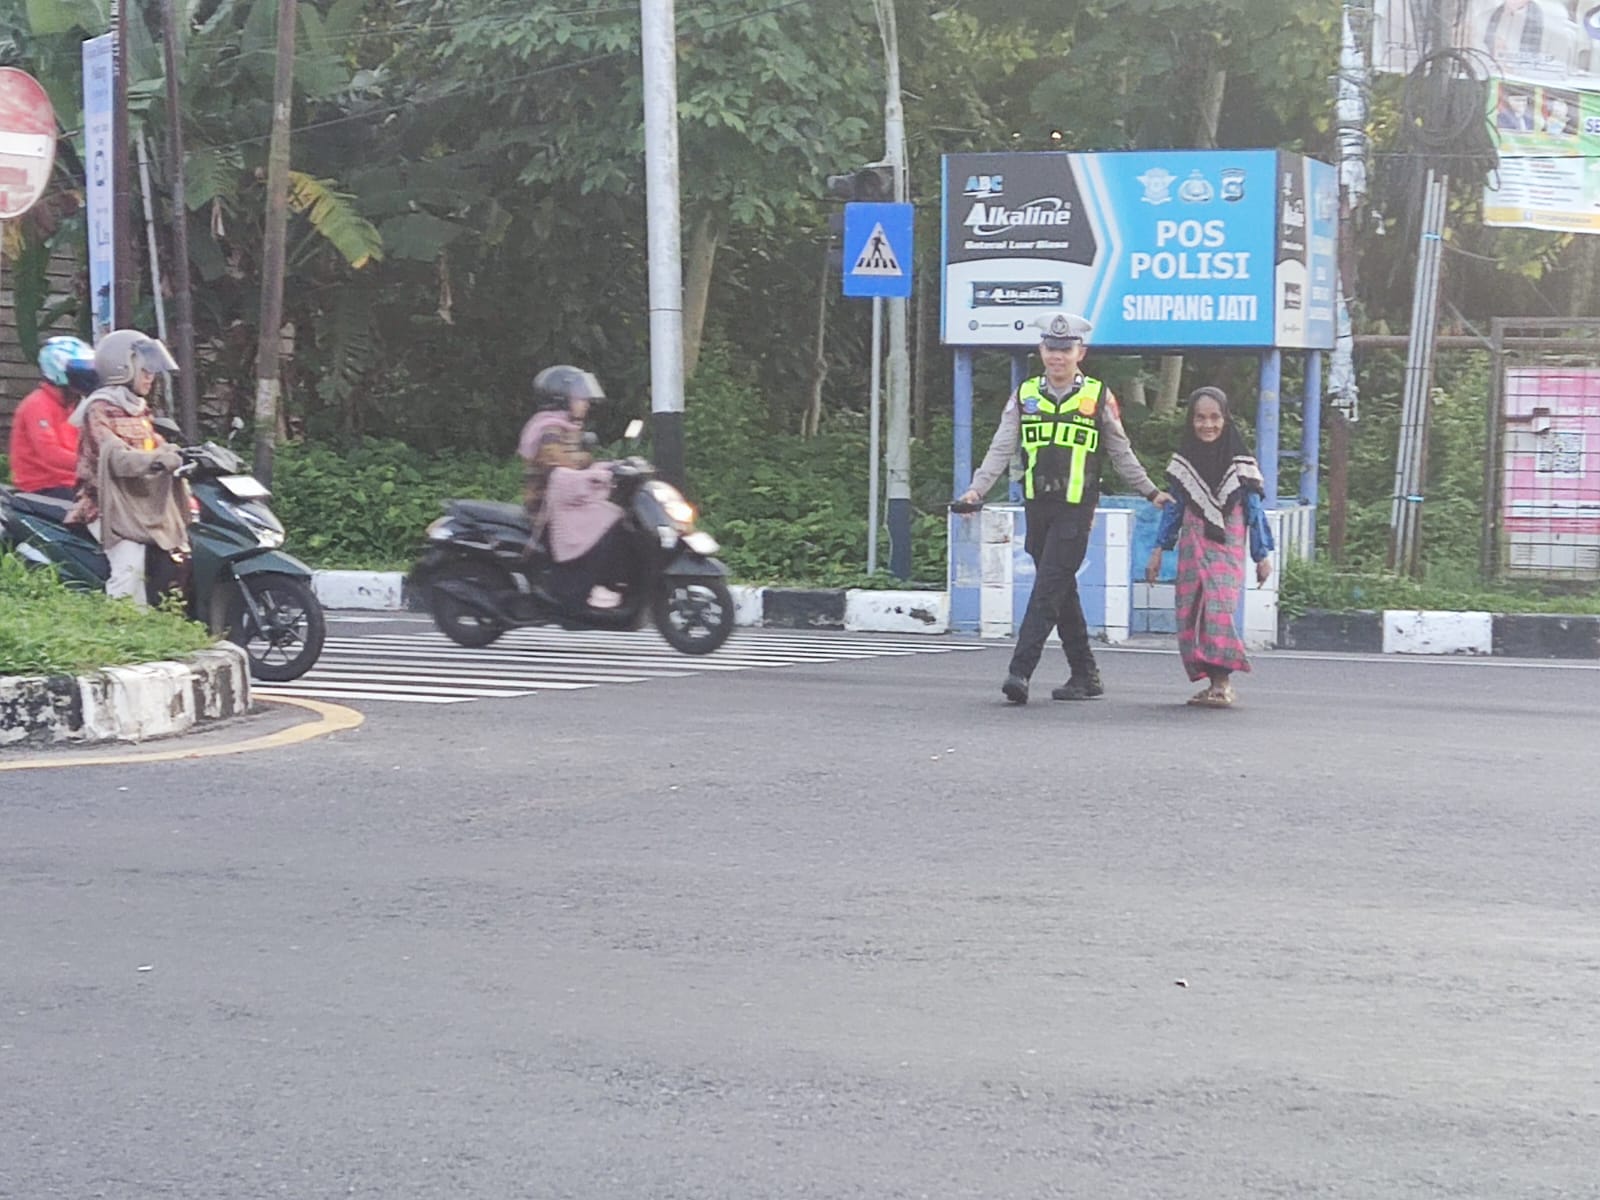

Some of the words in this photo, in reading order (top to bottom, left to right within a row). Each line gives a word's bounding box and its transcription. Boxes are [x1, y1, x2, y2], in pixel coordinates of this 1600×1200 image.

[964, 175, 1004, 192] ABC
[963, 201, 1072, 226] Alkaline
[1156, 219, 1226, 248] POS
[1130, 251, 1251, 280] POLISI
[1122, 294, 1214, 321] SIMPANG
[1216, 295, 1258, 321] JATI
